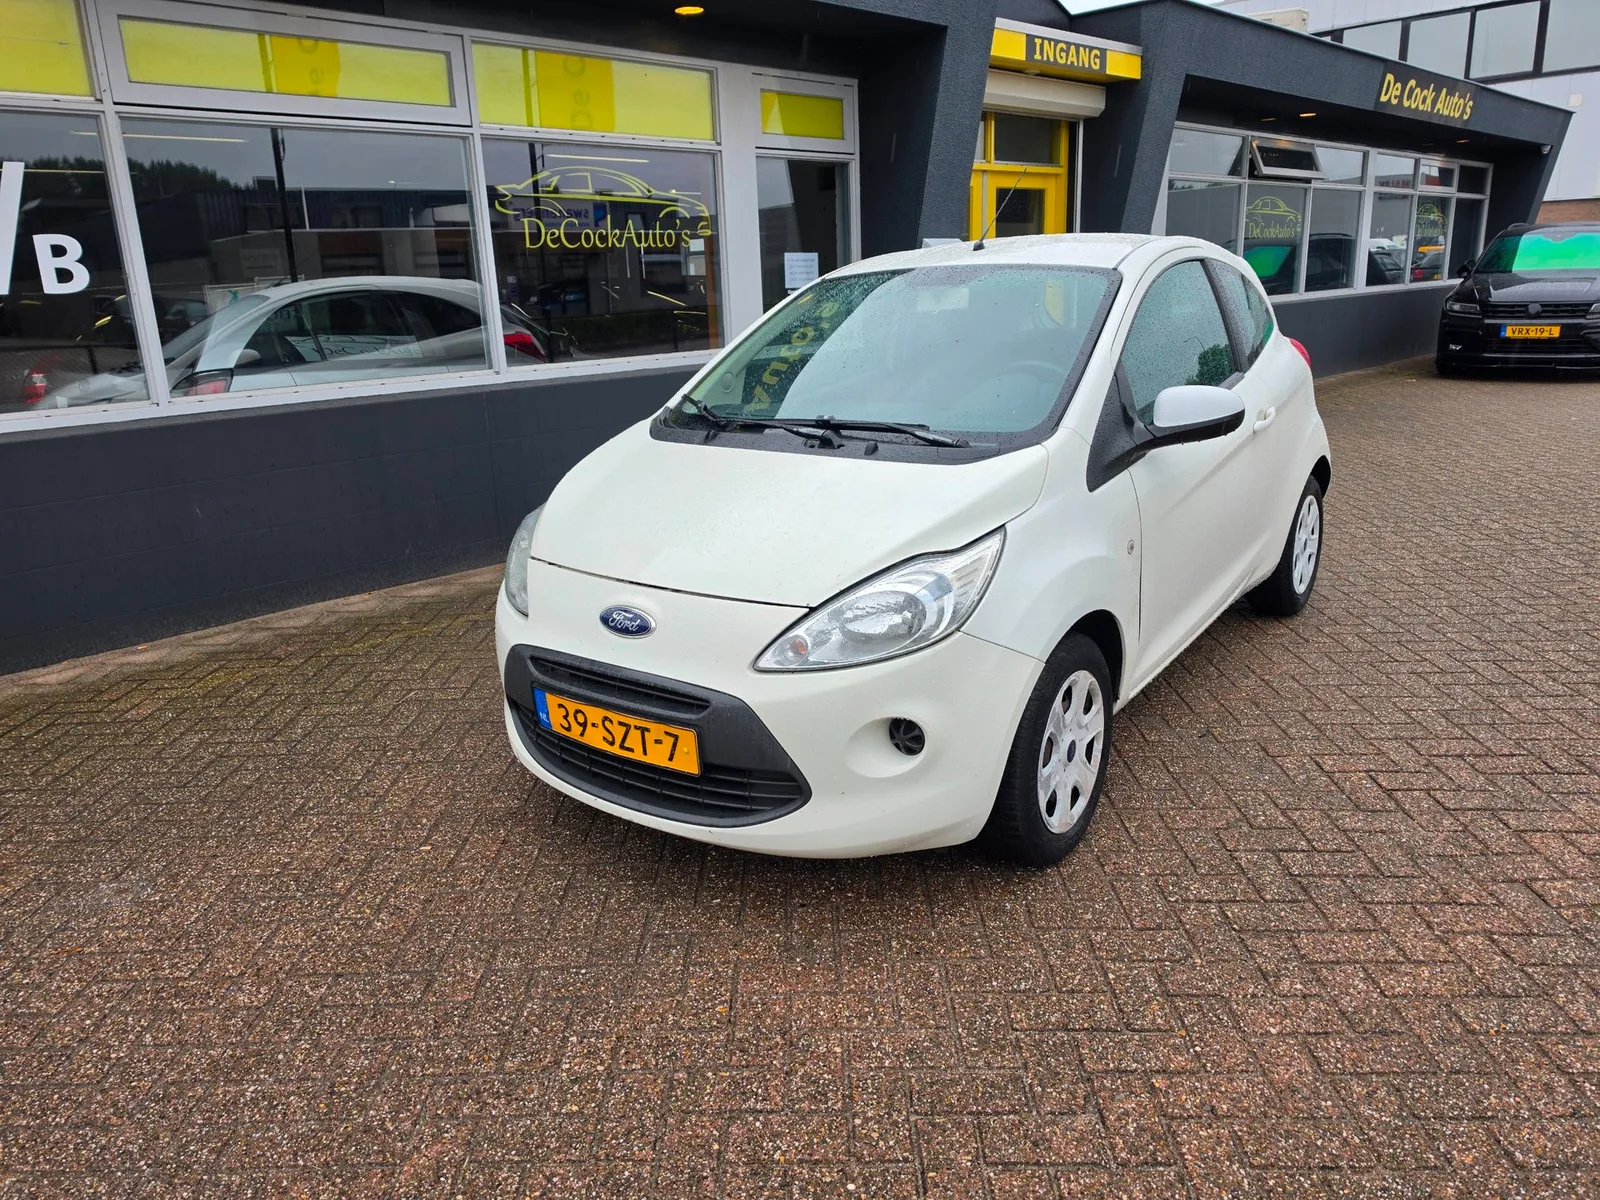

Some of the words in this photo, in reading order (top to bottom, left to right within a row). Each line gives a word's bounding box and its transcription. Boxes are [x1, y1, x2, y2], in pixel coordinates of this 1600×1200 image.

[1034, 38, 1100, 70] INGANG
[1380, 73, 1402, 105] De
[1403, 79, 1436, 112] Cock
[1434, 87, 1474, 120] Auto's
[520, 213, 691, 249] DeCockAuto's
[1511, 327, 1554, 336] VRX-19-L
[608, 610, 641, 631] Ford
[539, 711, 550, 723] NL
[557, 703, 679, 762] 39-SZT-7
